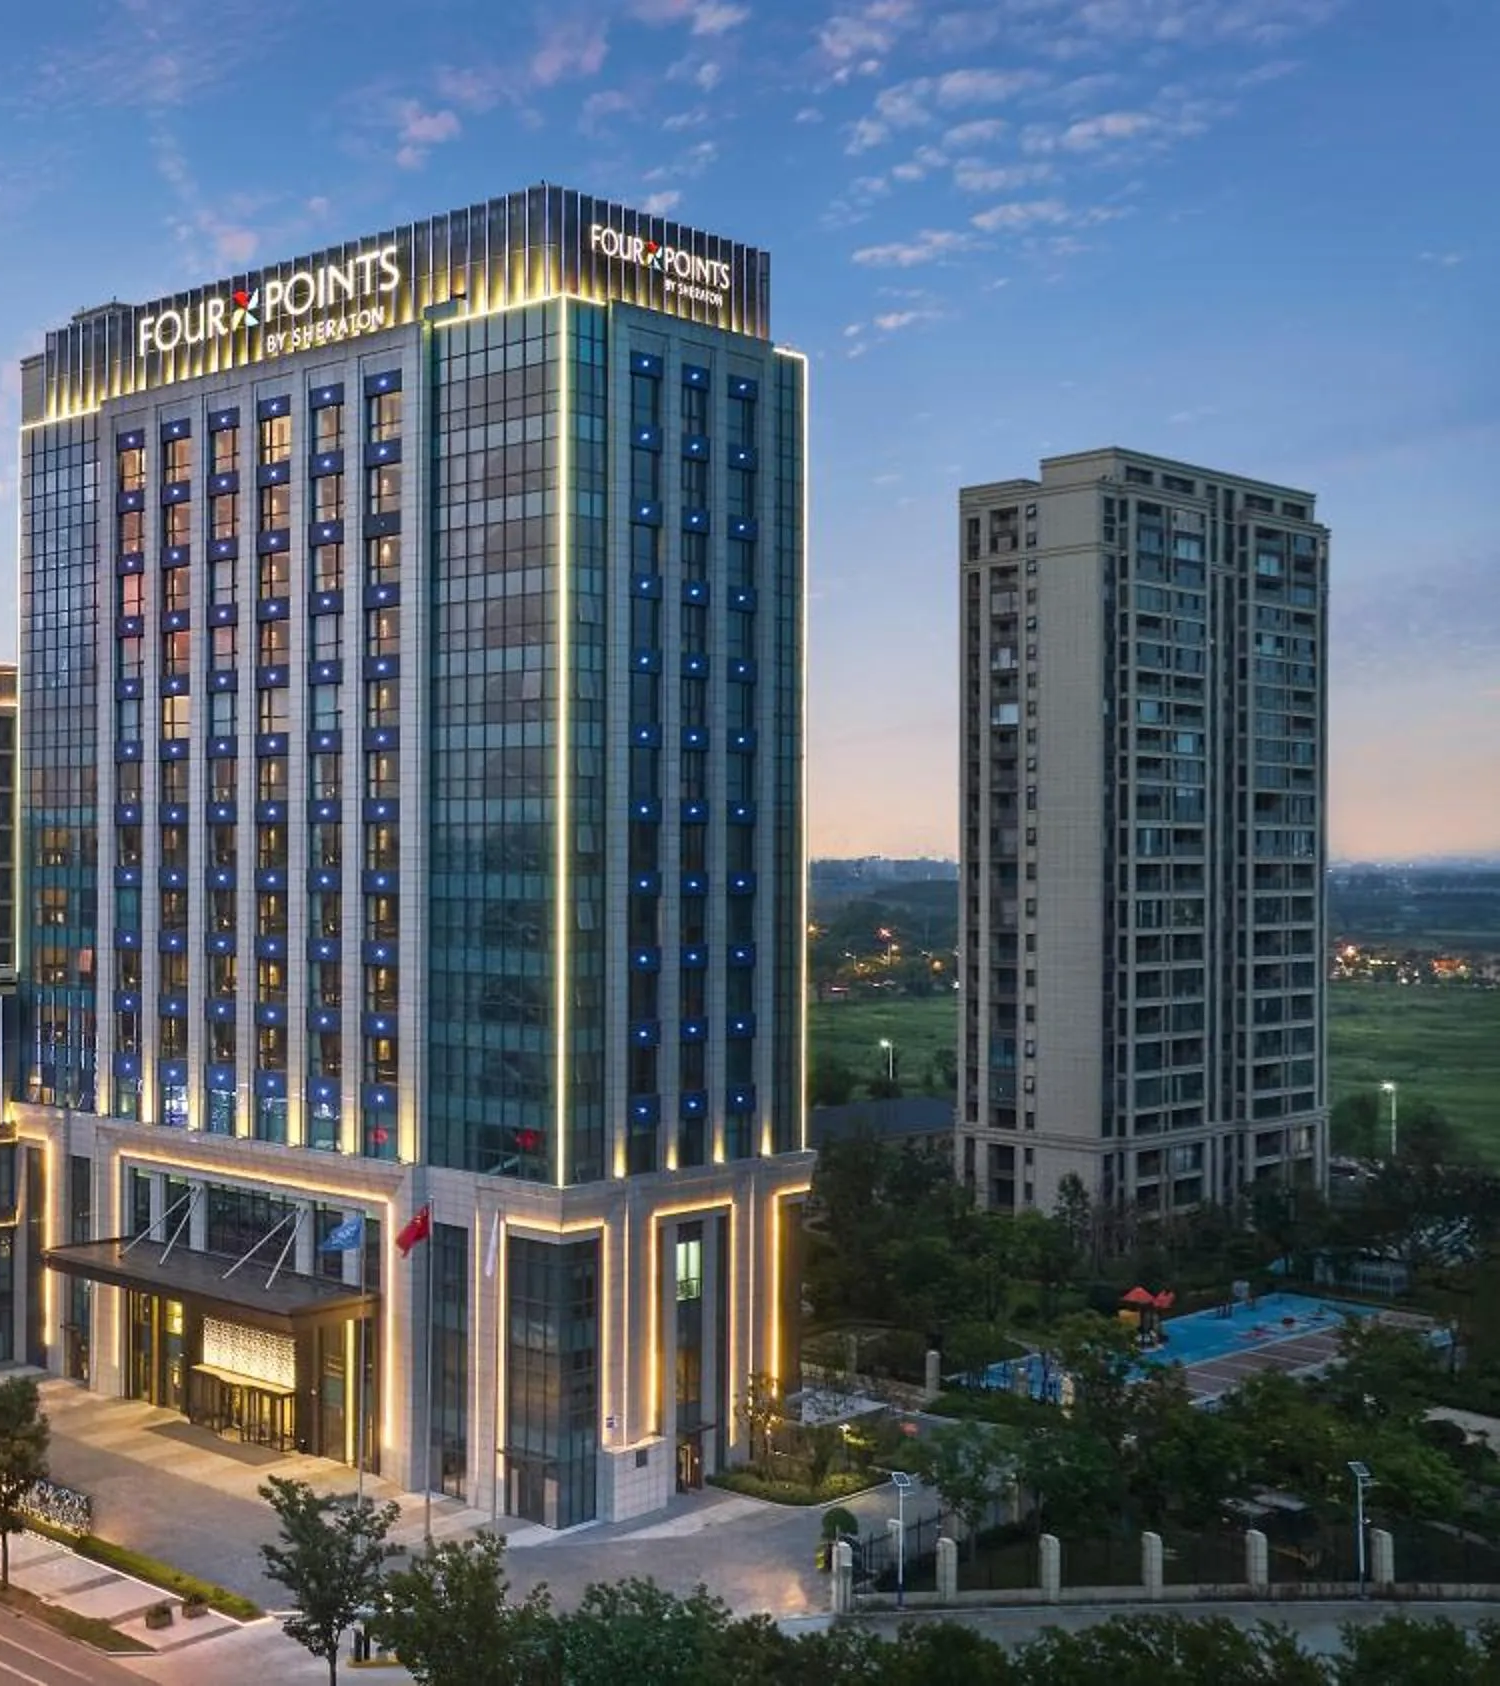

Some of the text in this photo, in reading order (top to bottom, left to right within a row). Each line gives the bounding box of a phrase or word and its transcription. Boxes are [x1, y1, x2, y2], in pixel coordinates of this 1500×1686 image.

[591, 224, 730, 289] FOUR POINTS
[139, 245, 400, 357] FOUR POINTS
[665, 279, 676, 292] BY
[267, 306, 385, 353] BY SHERATON
